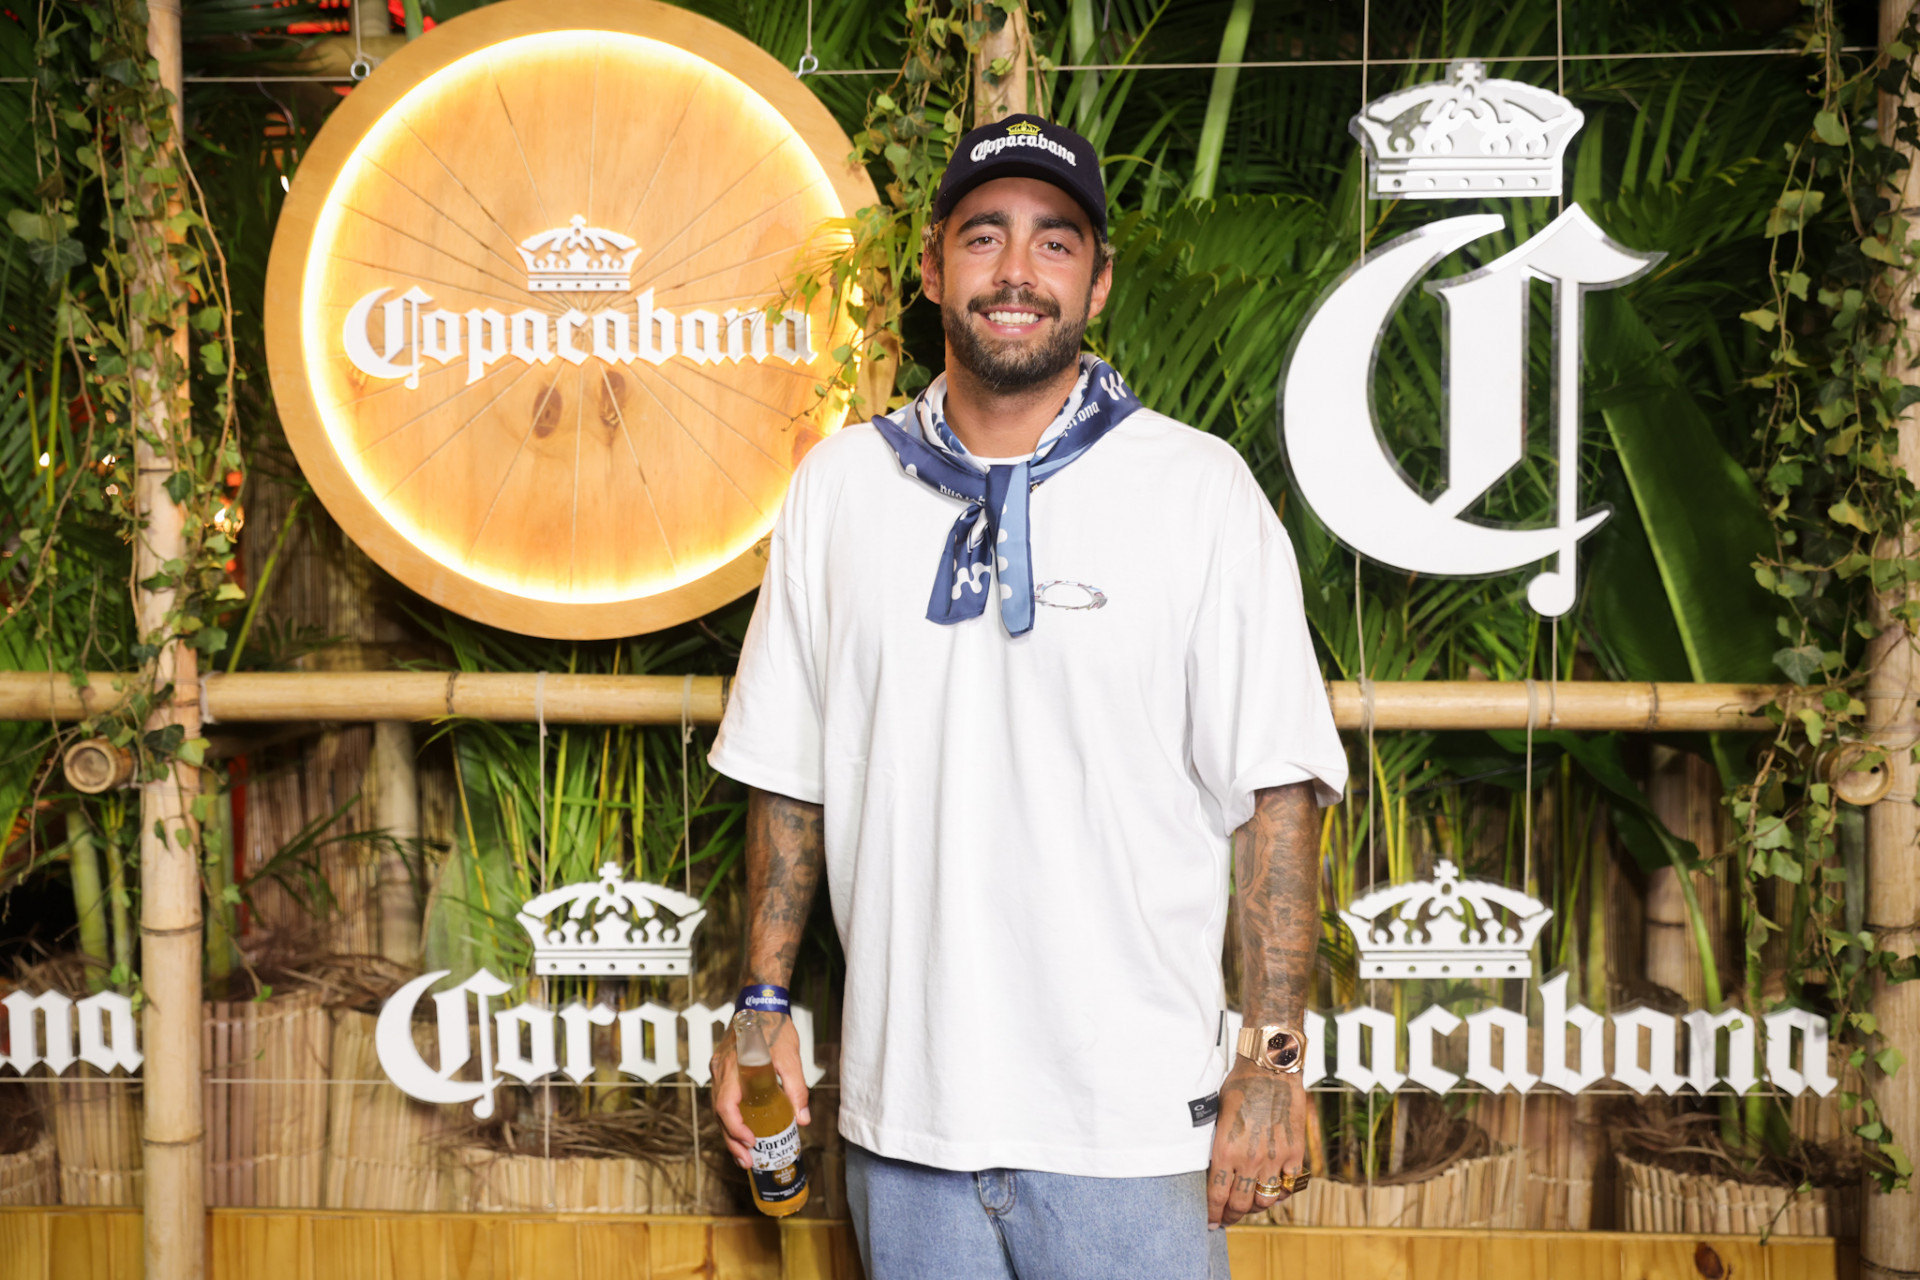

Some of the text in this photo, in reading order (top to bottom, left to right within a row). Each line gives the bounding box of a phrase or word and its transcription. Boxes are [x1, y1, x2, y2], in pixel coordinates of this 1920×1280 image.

[970, 133, 1077, 166] Copacabana
[343, 286, 818, 390] Copacabana
[0, 989, 144, 1077] na
[1227, 970, 1838, 1098] acabana
[753, 1126, 797, 1154] Corona
[768, 1144, 795, 1160] Extra
